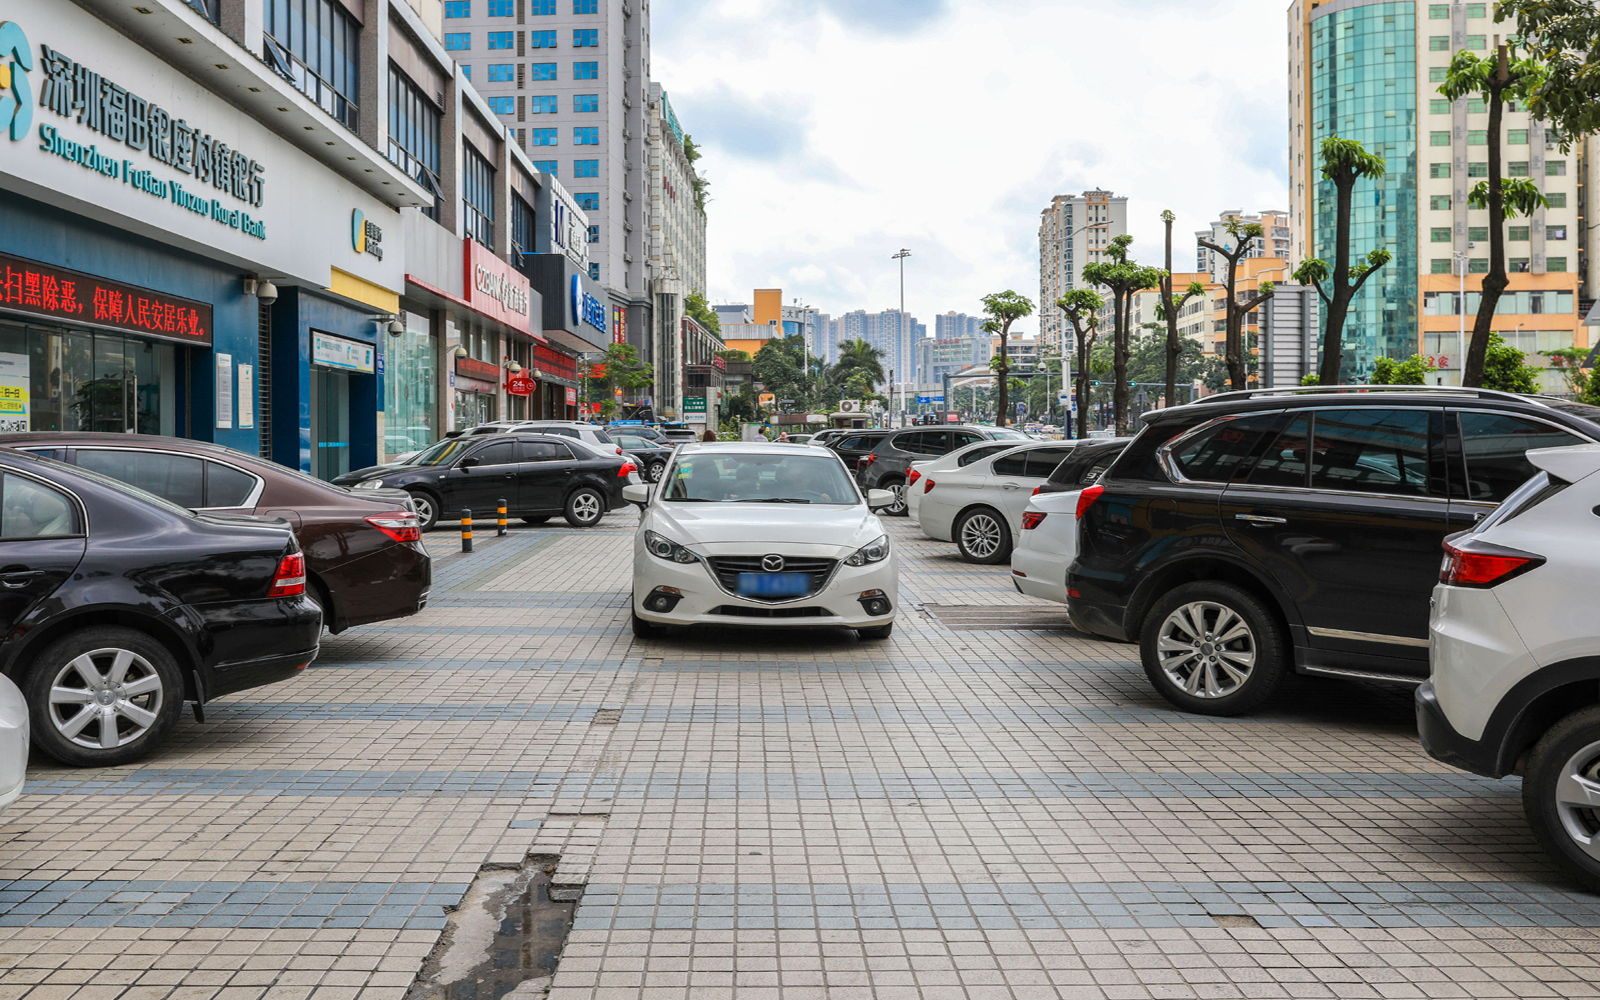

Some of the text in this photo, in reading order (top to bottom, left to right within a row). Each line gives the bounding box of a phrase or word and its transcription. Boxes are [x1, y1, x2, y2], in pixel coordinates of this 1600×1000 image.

[41, 44, 265, 207] 深圳福田银座村镇银行
[40, 122, 266, 240] Shenzhen Futian Yinzuo Rural Bank
[0, 266, 205, 336] 扫黑除恶，保障人民安居乐业。
[475, 263, 503, 302] CZBANK
